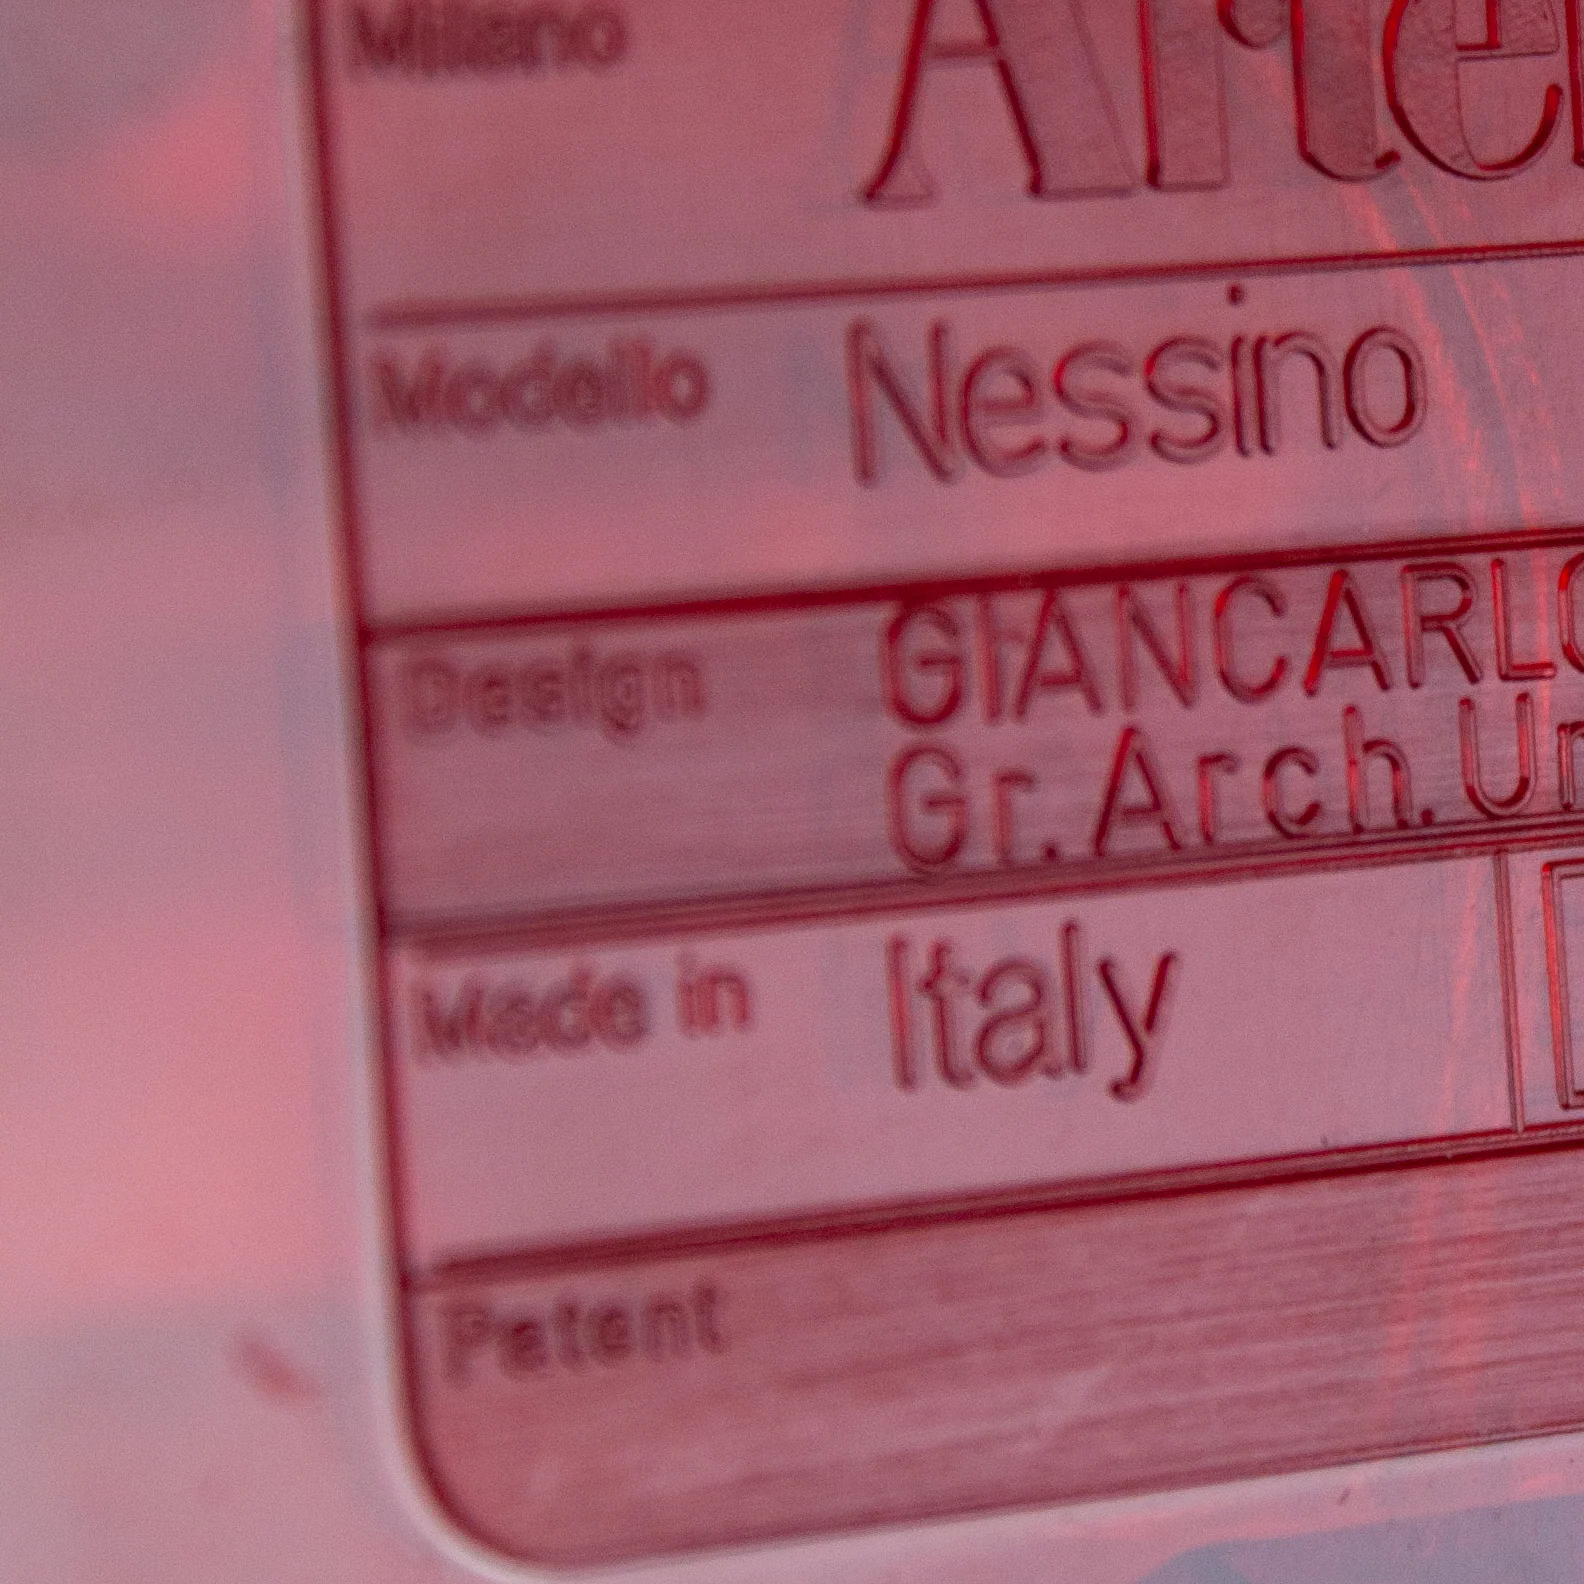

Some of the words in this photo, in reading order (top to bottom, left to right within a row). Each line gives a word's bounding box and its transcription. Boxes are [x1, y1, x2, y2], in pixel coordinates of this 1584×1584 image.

[373, 341, 711, 436] Modello
[845, 283, 1428, 486] Nessino
[403, 650, 706, 744] Design
[416, 968, 649, 1061] Made
[678, 955, 752, 1037] in
[886, 917, 1182, 1103] Italy
[440, 1282, 727, 1379] Patent
